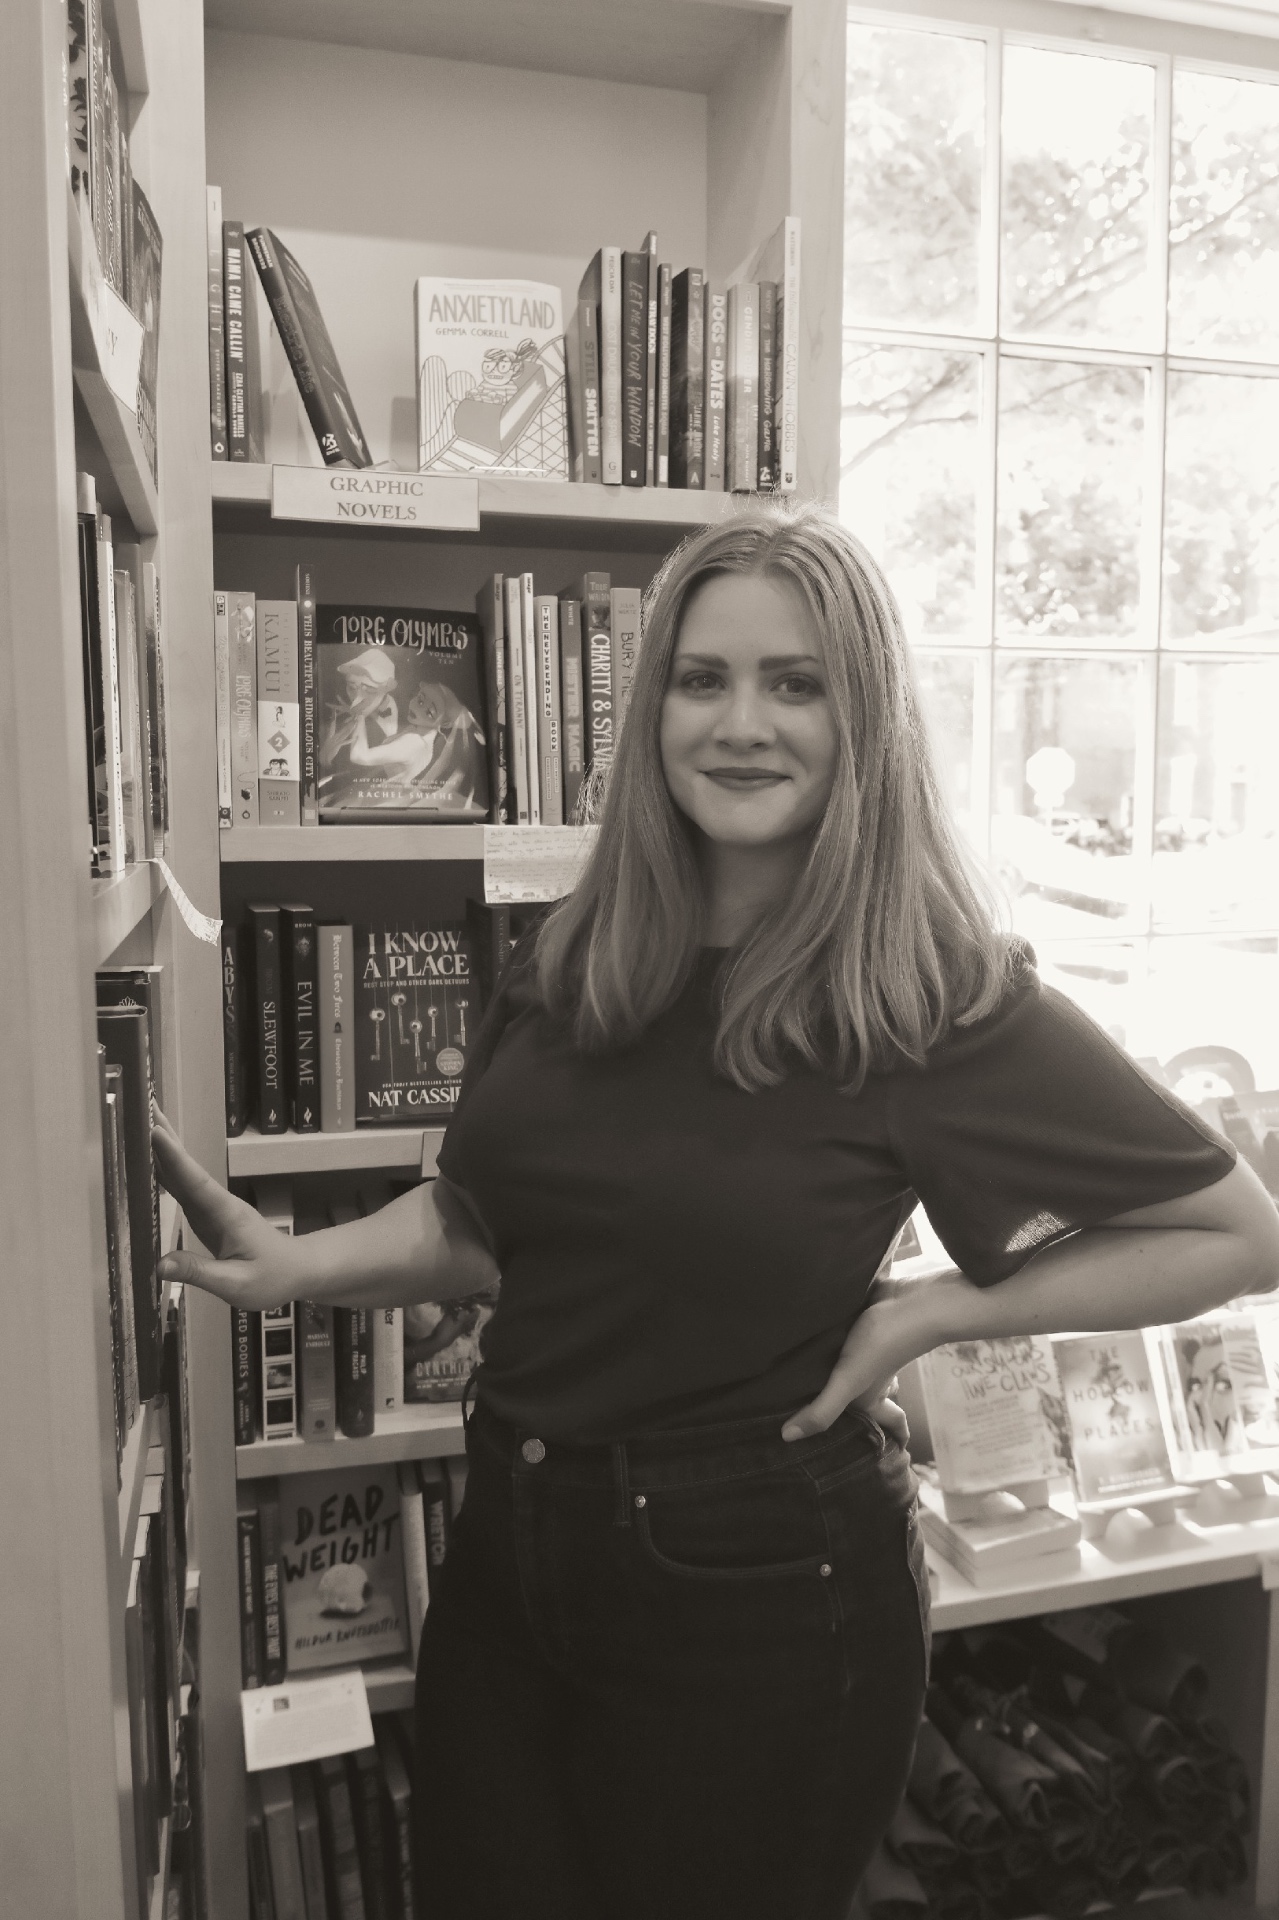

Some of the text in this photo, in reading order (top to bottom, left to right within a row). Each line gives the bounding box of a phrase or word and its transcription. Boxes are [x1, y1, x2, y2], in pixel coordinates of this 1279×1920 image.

[226, 248, 244, 364] MAMA CAME CALLIN'
[428, 293, 555, 330] ANXIETYLAND
[712, 294, 725, 344] DOGS
[435, 327, 509, 338] GEMMA CORRELL
[714, 346, 722, 358] on
[627, 280, 644, 448] LET ME IN YOUR WINDOW
[710, 359, 724, 409] DATES
[785, 343, 796, 390] CALVIN
[661, 378, 669, 410] MONSTER
[237, 414, 246, 438] DANIELS
[585, 388, 599, 457] SMITTEN
[784, 403, 796, 453] HOBBES
[712, 438, 720, 461] Healy
[330, 476, 424, 497] GRAPHIC
[336, 502, 417, 521] NOVELS
[264, 613, 280, 693] KAMUI
[333, 616, 468, 656] LORE OLYMPUS
[620, 632, 634, 670] BURY
[543, 633, 552, 716] NEVERENDING
[590, 634, 612, 696] CHARITY
[304, 614, 314, 779] THIS BEAUTIFUL, RIDICULOUS CITY
[514, 674, 524, 729] ON TYRANNY
[564, 657, 580, 772] MISTER MAGIC
[592, 700, 612, 712] &
[274, 737, 284, 747] 2
[358, 791, 453, 801] RACHEL SMYTHE
[332, 934, 343, 970] Between
[368, 930, 462, 955] I KNOW
[363, 953, 470, 980] A PLACE
[428, 978, 444, 986] DARK
[444, 978, 470, 986] DETOURS
[262, 1001, 278, 1090] SLEWFOOT
[297, 981, 314, 1086] EVIL IN ME
[368, 1088, 402, 1108] NAT
[385, 1308, 395, 1326] ter
[238, 1309, 249, 1378] PED BODIES
[294, 1484, 384, 1546] DEAD
[282, 1511, 400, 1583] WEIGHT
